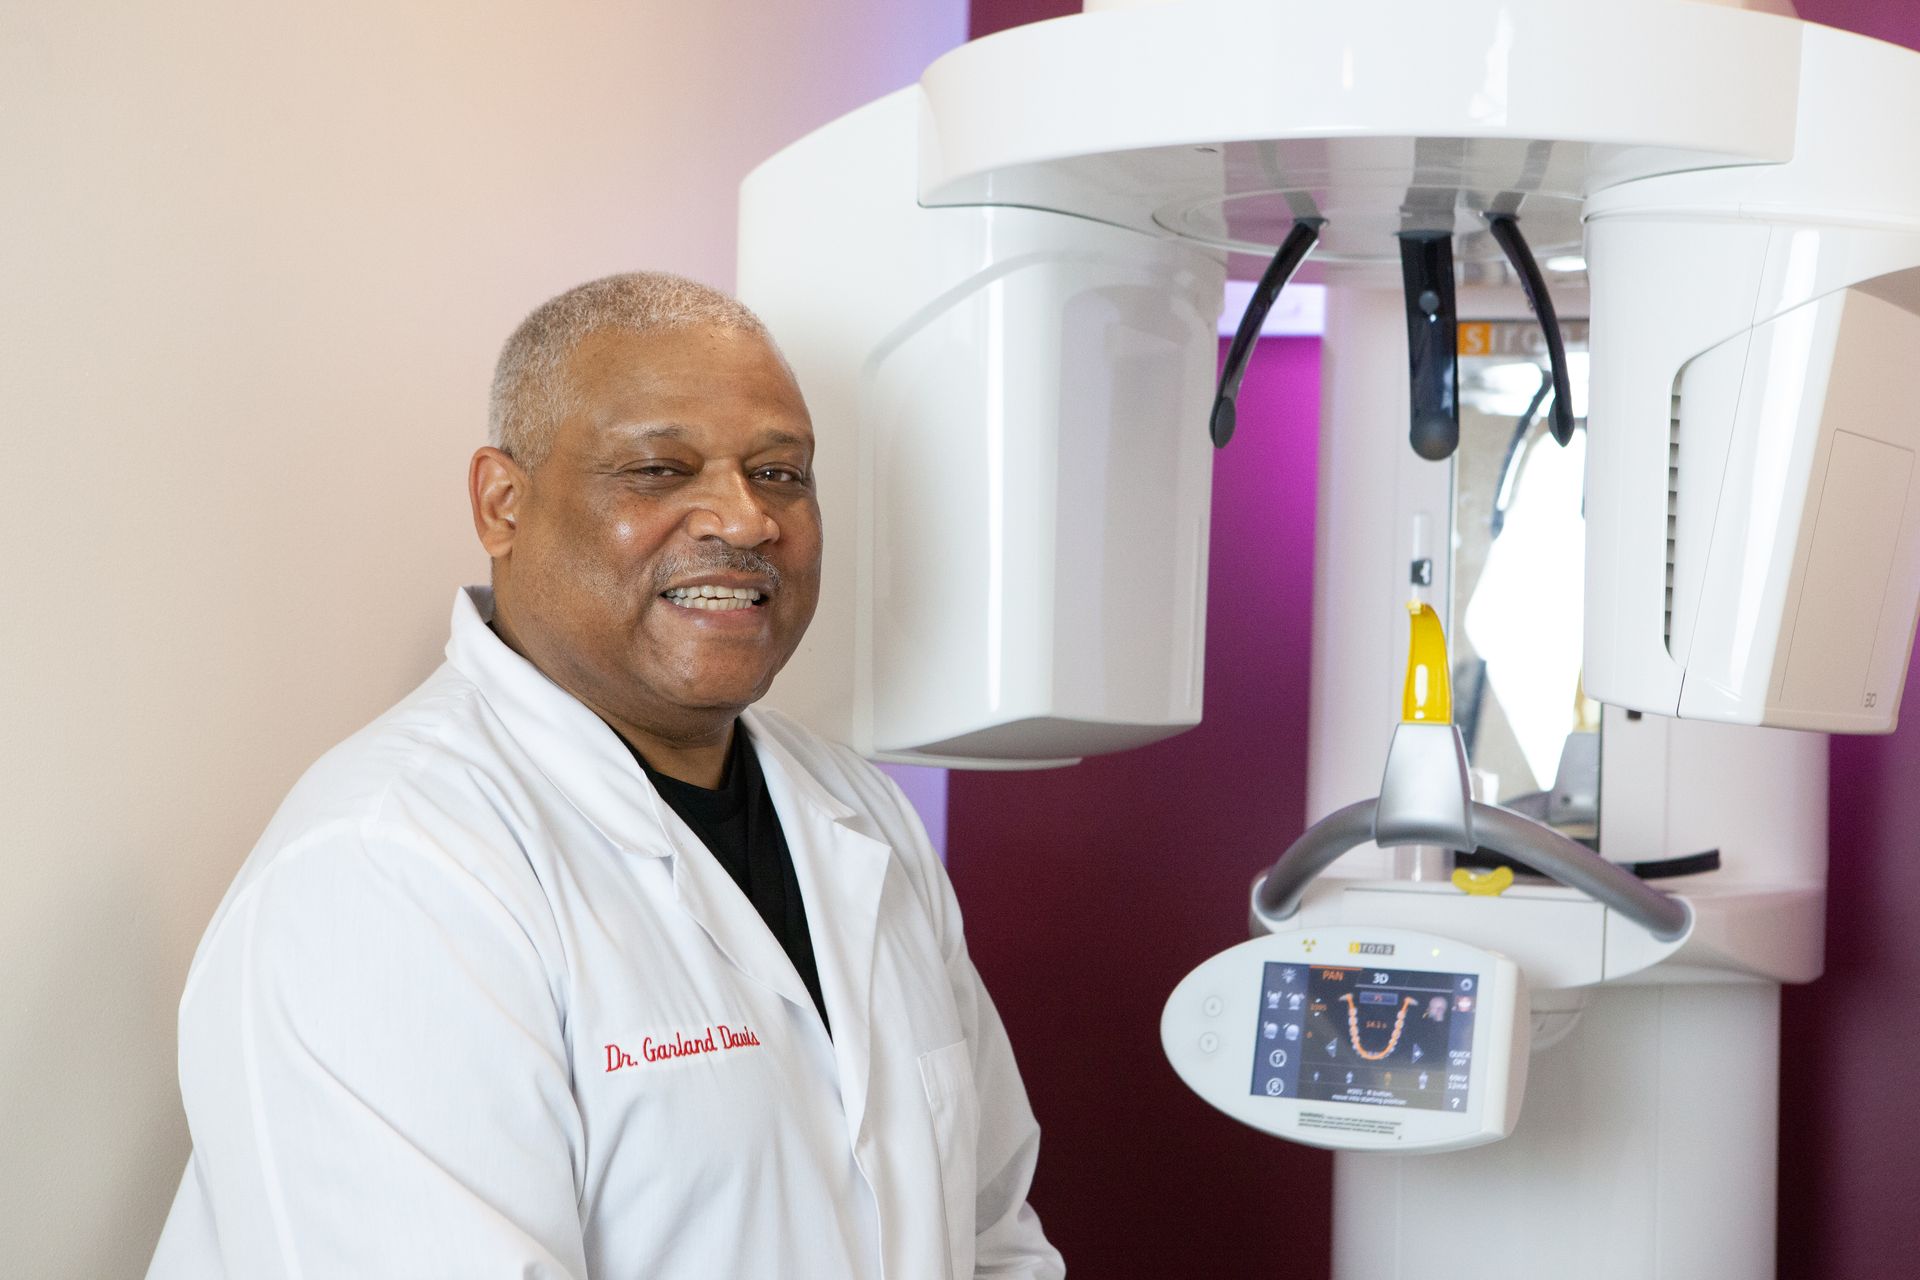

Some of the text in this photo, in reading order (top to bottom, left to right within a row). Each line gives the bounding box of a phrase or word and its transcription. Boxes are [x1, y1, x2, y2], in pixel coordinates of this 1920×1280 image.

[1322, 970, 1344, 981] PAN
[1372, 972, 1389, 984] 3D
[604, 1024, 760, 1072] Dr. Garland Davis
